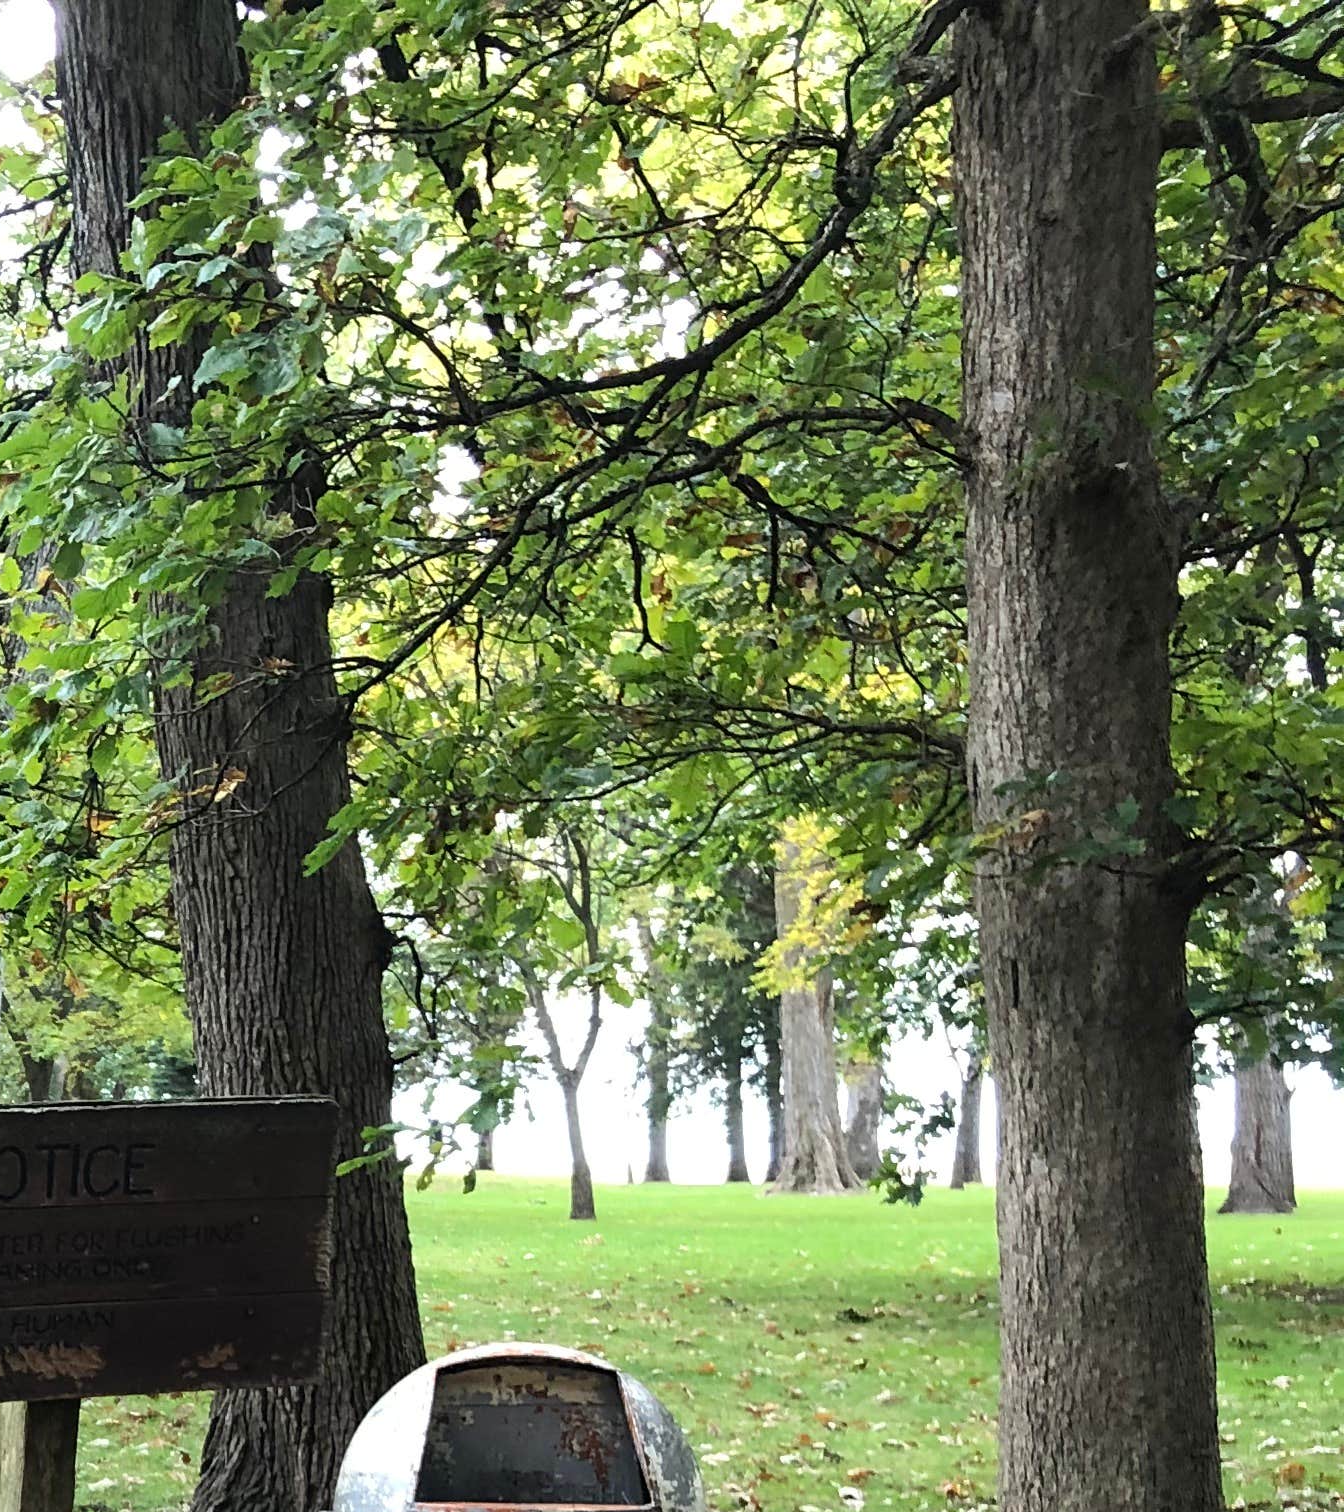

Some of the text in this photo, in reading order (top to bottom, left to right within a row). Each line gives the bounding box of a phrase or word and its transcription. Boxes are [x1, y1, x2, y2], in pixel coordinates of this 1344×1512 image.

[56, 1231, 103, 1254] FOR
[115, 1222, 245, 1250] FLUSHING
[12, 1309, 114, 1337] HUMAN
